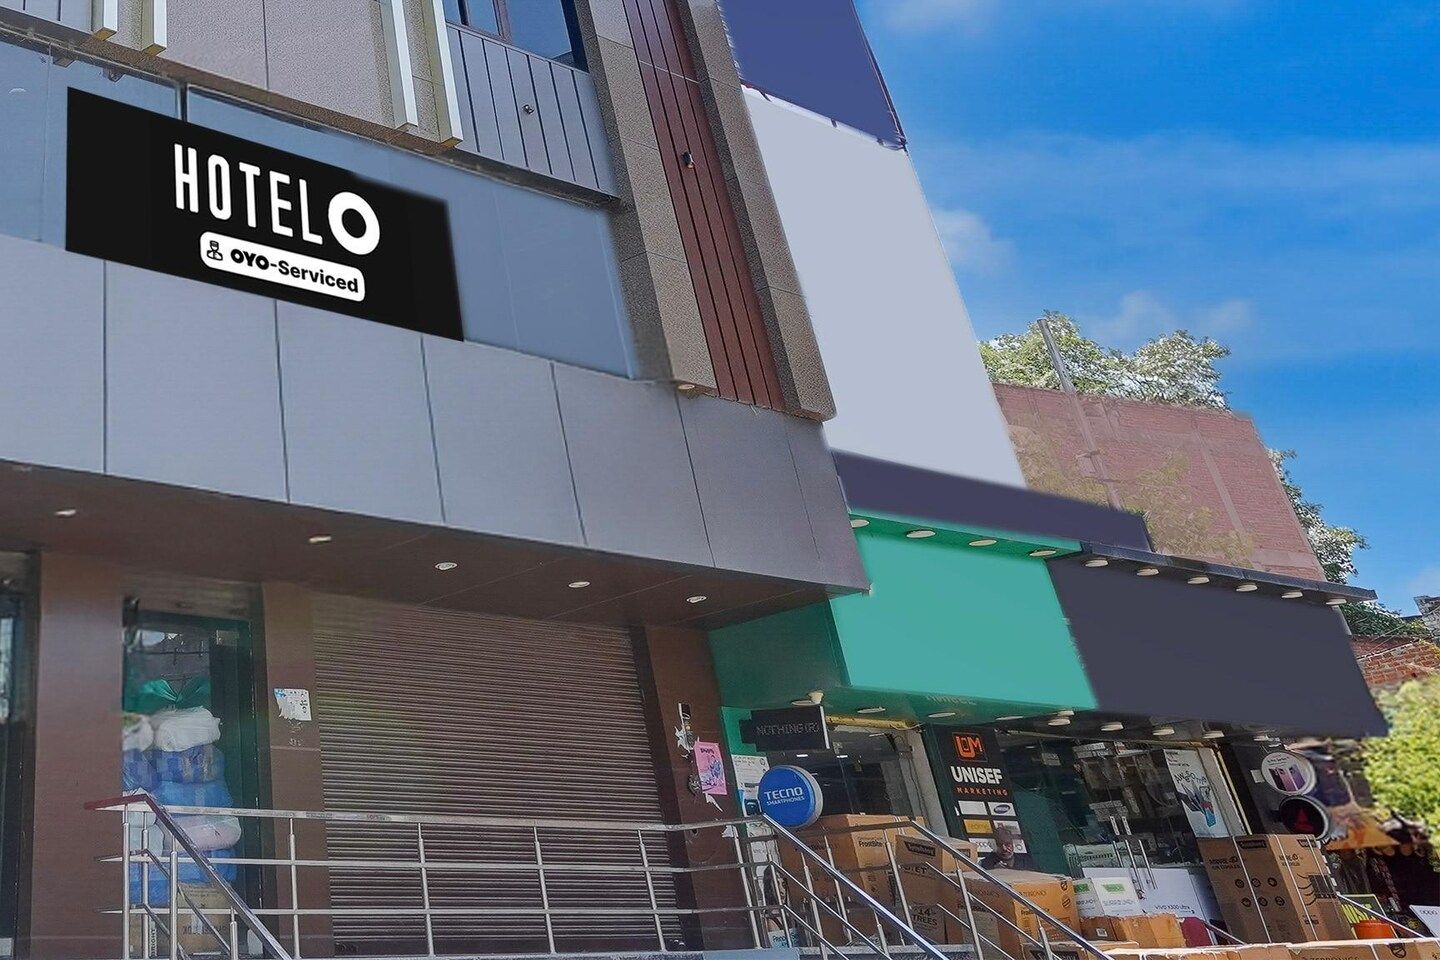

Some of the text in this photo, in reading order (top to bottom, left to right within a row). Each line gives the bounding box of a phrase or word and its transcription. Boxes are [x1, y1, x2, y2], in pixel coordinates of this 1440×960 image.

[174, 143, 380, 256] HOTEL O
[230, 247, 359, 294] OYO-Serviced
[950, 765, 1003, 785] UNISEF
[763, 786, 803, 801] TECNO
[956, 787, 1009, 796] MARKETING
